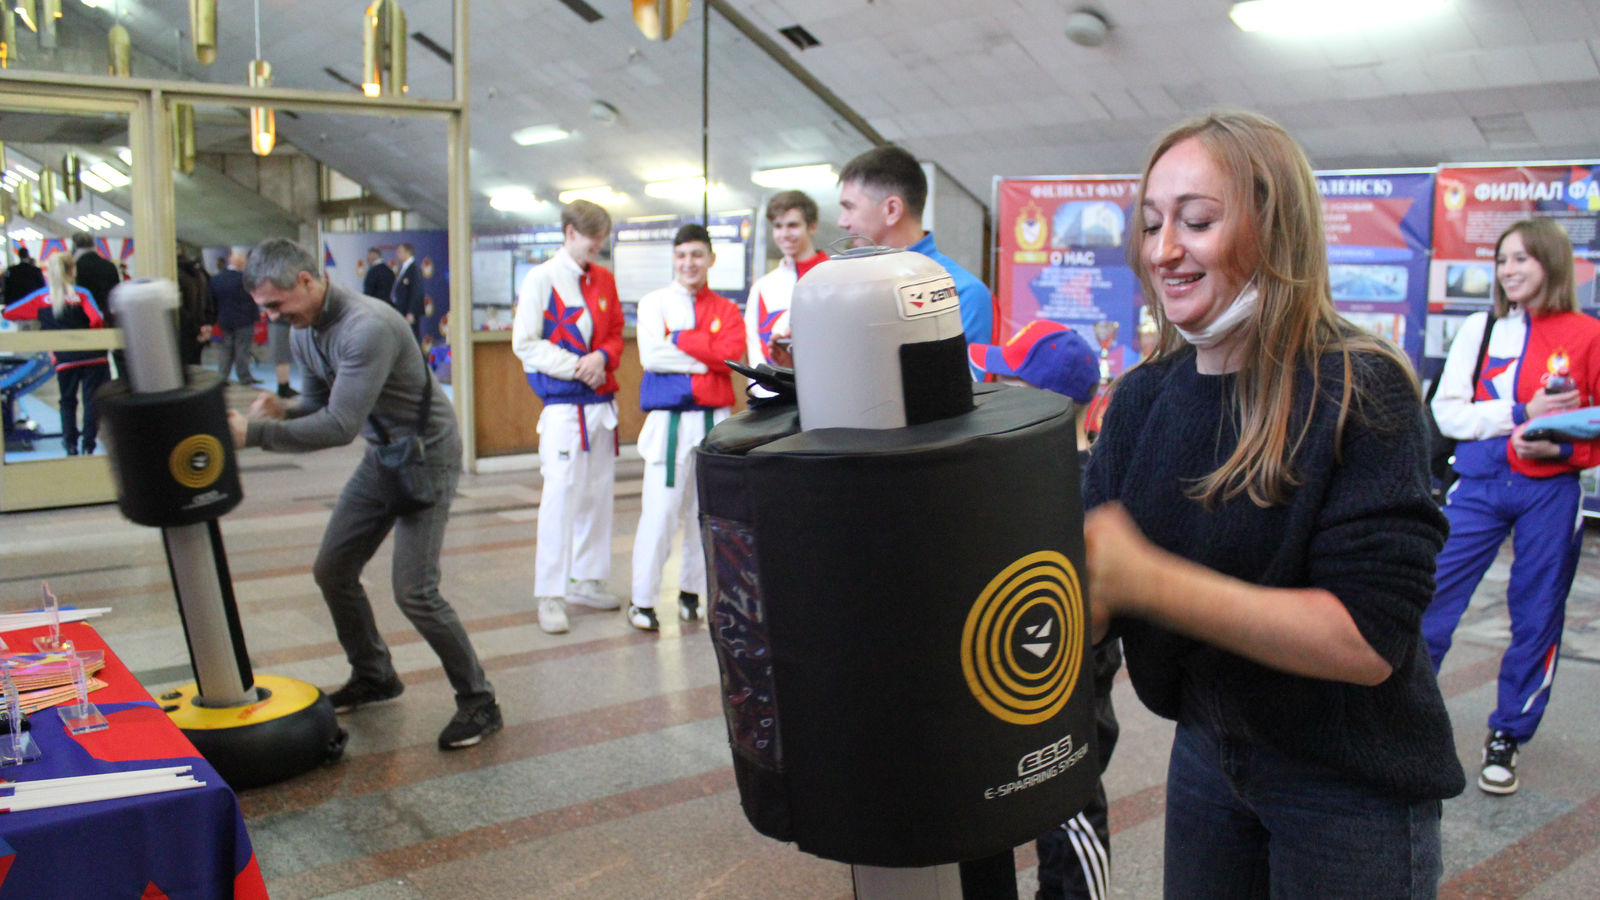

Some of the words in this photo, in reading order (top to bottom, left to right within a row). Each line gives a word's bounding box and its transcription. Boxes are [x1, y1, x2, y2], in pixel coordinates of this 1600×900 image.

[1474, 181, 1564, 201] ФИЛИАЛ
[1050, 251, 1063, 266] О
[1064, 251, 1095, 265] НАС
[984, 764, 1059, 800] E-SPARRING
